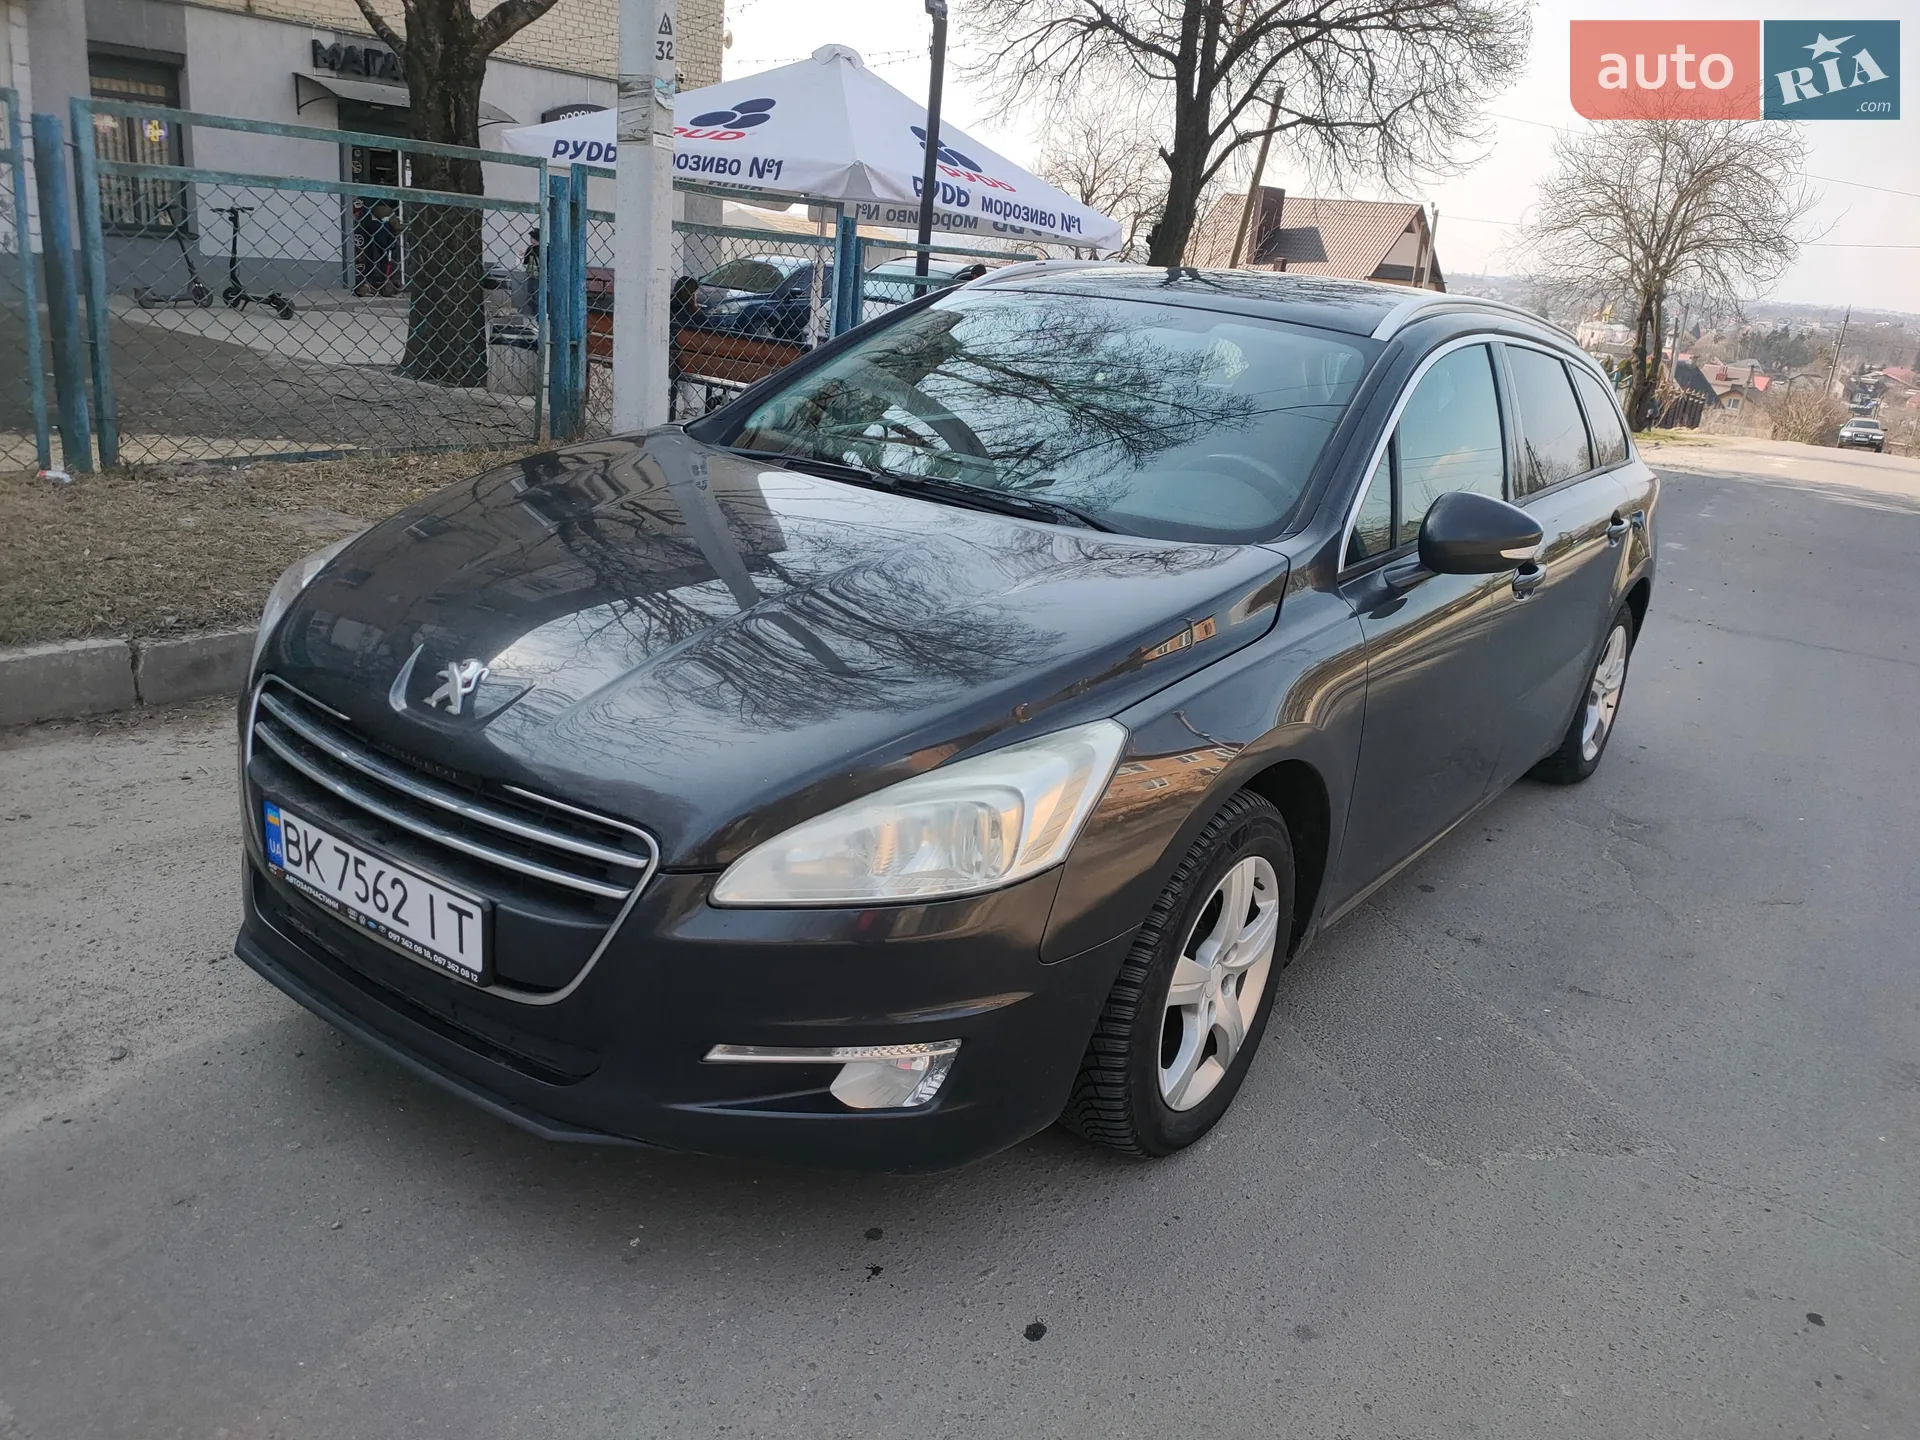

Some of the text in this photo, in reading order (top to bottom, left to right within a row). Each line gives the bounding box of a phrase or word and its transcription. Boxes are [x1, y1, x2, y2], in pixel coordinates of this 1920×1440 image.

[655, 41, 674, 60] 32
[673, 153, 742, 176] озиво
[748, 157, 784, 181] №1
[269, 838, 282, 857] UA
[283, 819, 474, 955] BK 7562 IT
